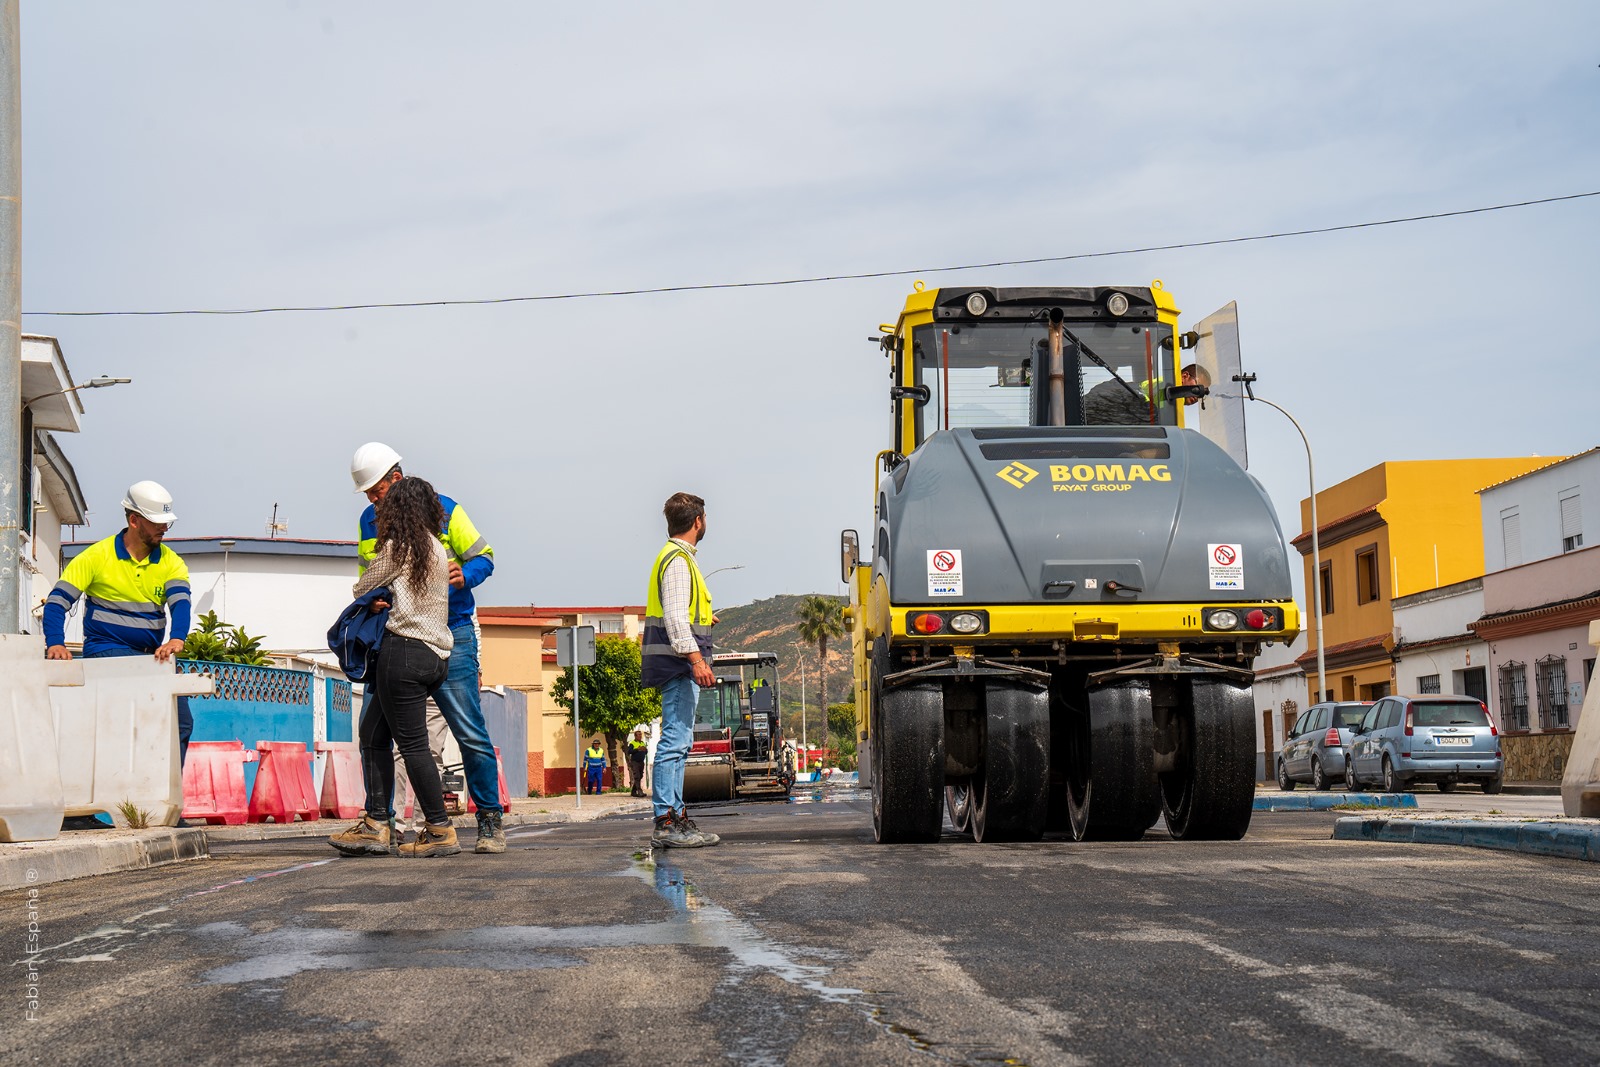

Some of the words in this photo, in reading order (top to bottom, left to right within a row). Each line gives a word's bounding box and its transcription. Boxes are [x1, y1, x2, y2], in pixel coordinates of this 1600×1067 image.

[1049, 464, 1172, 482] BOMAG
[1052, 484, 1088, 492] FAYAT
[1091, 483, 1132, 492] GROUP
